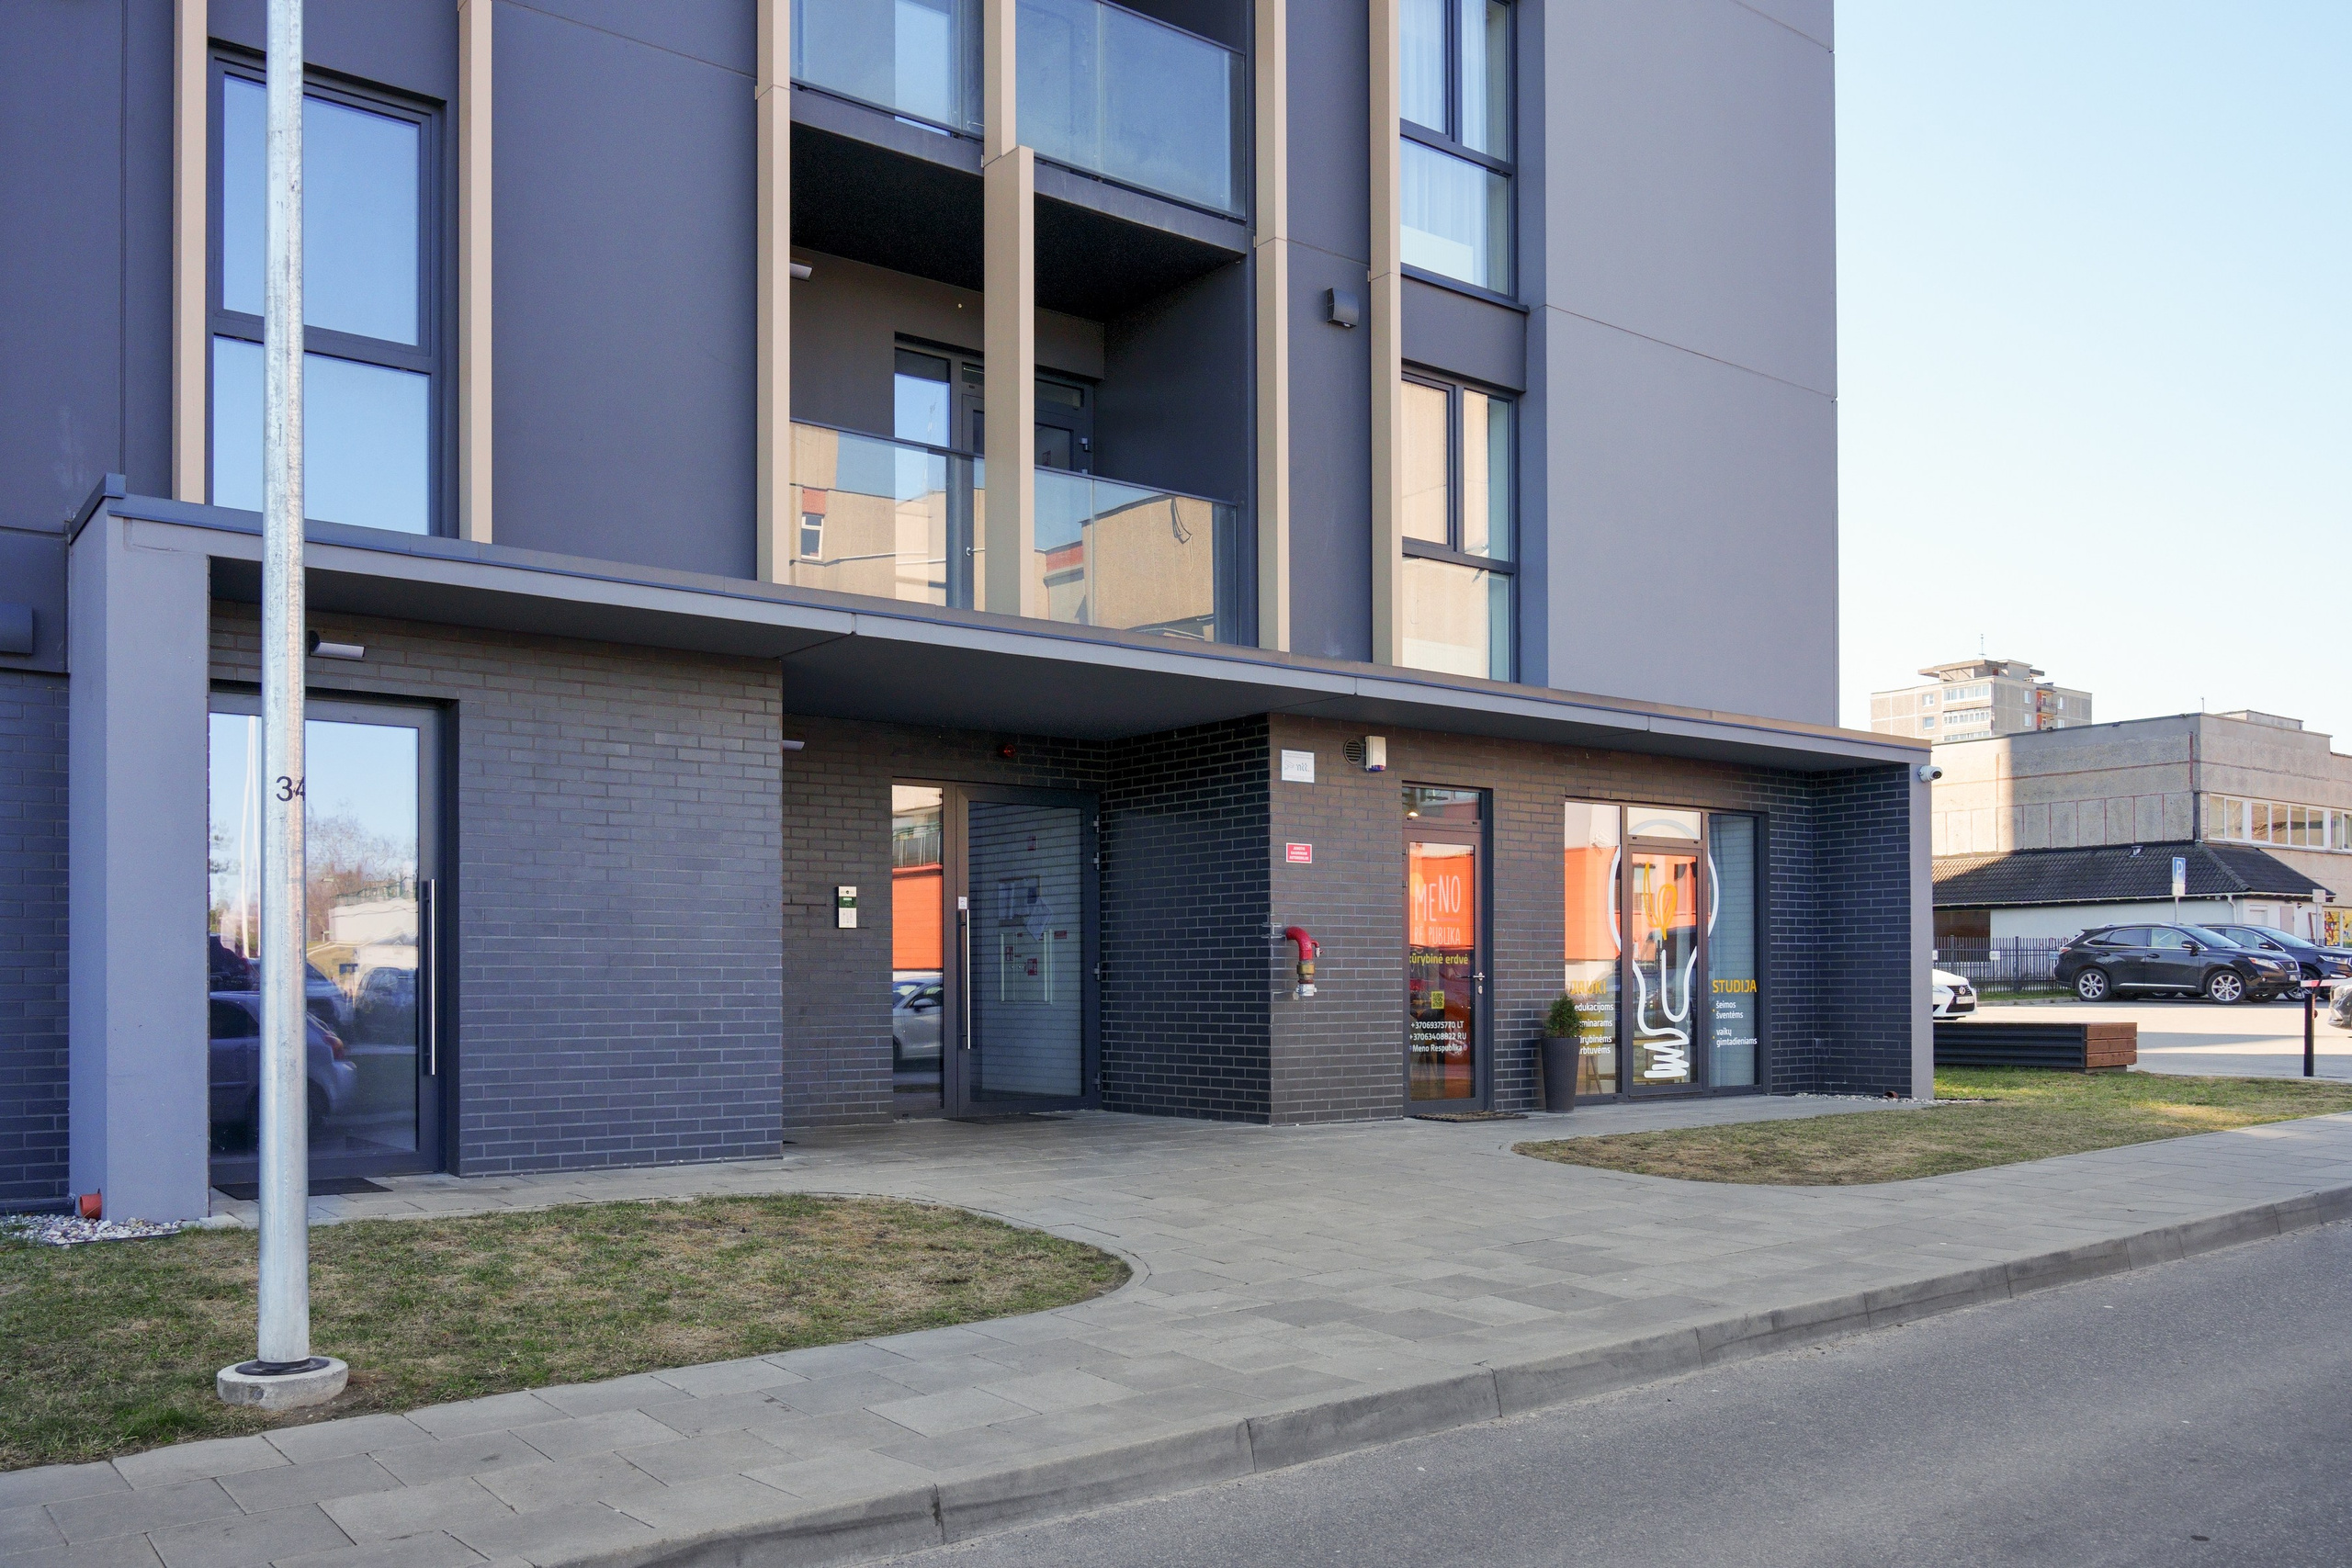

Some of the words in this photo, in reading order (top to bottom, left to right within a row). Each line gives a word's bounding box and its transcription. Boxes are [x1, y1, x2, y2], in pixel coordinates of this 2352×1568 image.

[276, 775, 305, 802] 34
[2177, 861, 2184, 881] P
[1414, 874, 1461, 922] MENO
[1445, 953, 1469, 964] erdvė
[1712, 979, 1758, 993] STUDIJA
[1574, 1002, 1614, 1012] edukacijoms
[1715, 1000, 1736, 1009] šeimos
[1715, 1010, 1744, 1020] šventėms
[1716, 1037, 1758, 1048] gimtadieniams
[1412, 1043, 1430, 1053] Meno
[1430, 1043, 1463, 1054] Respublika
[1578, 1045, 1611, 1055] rbtuvėms
